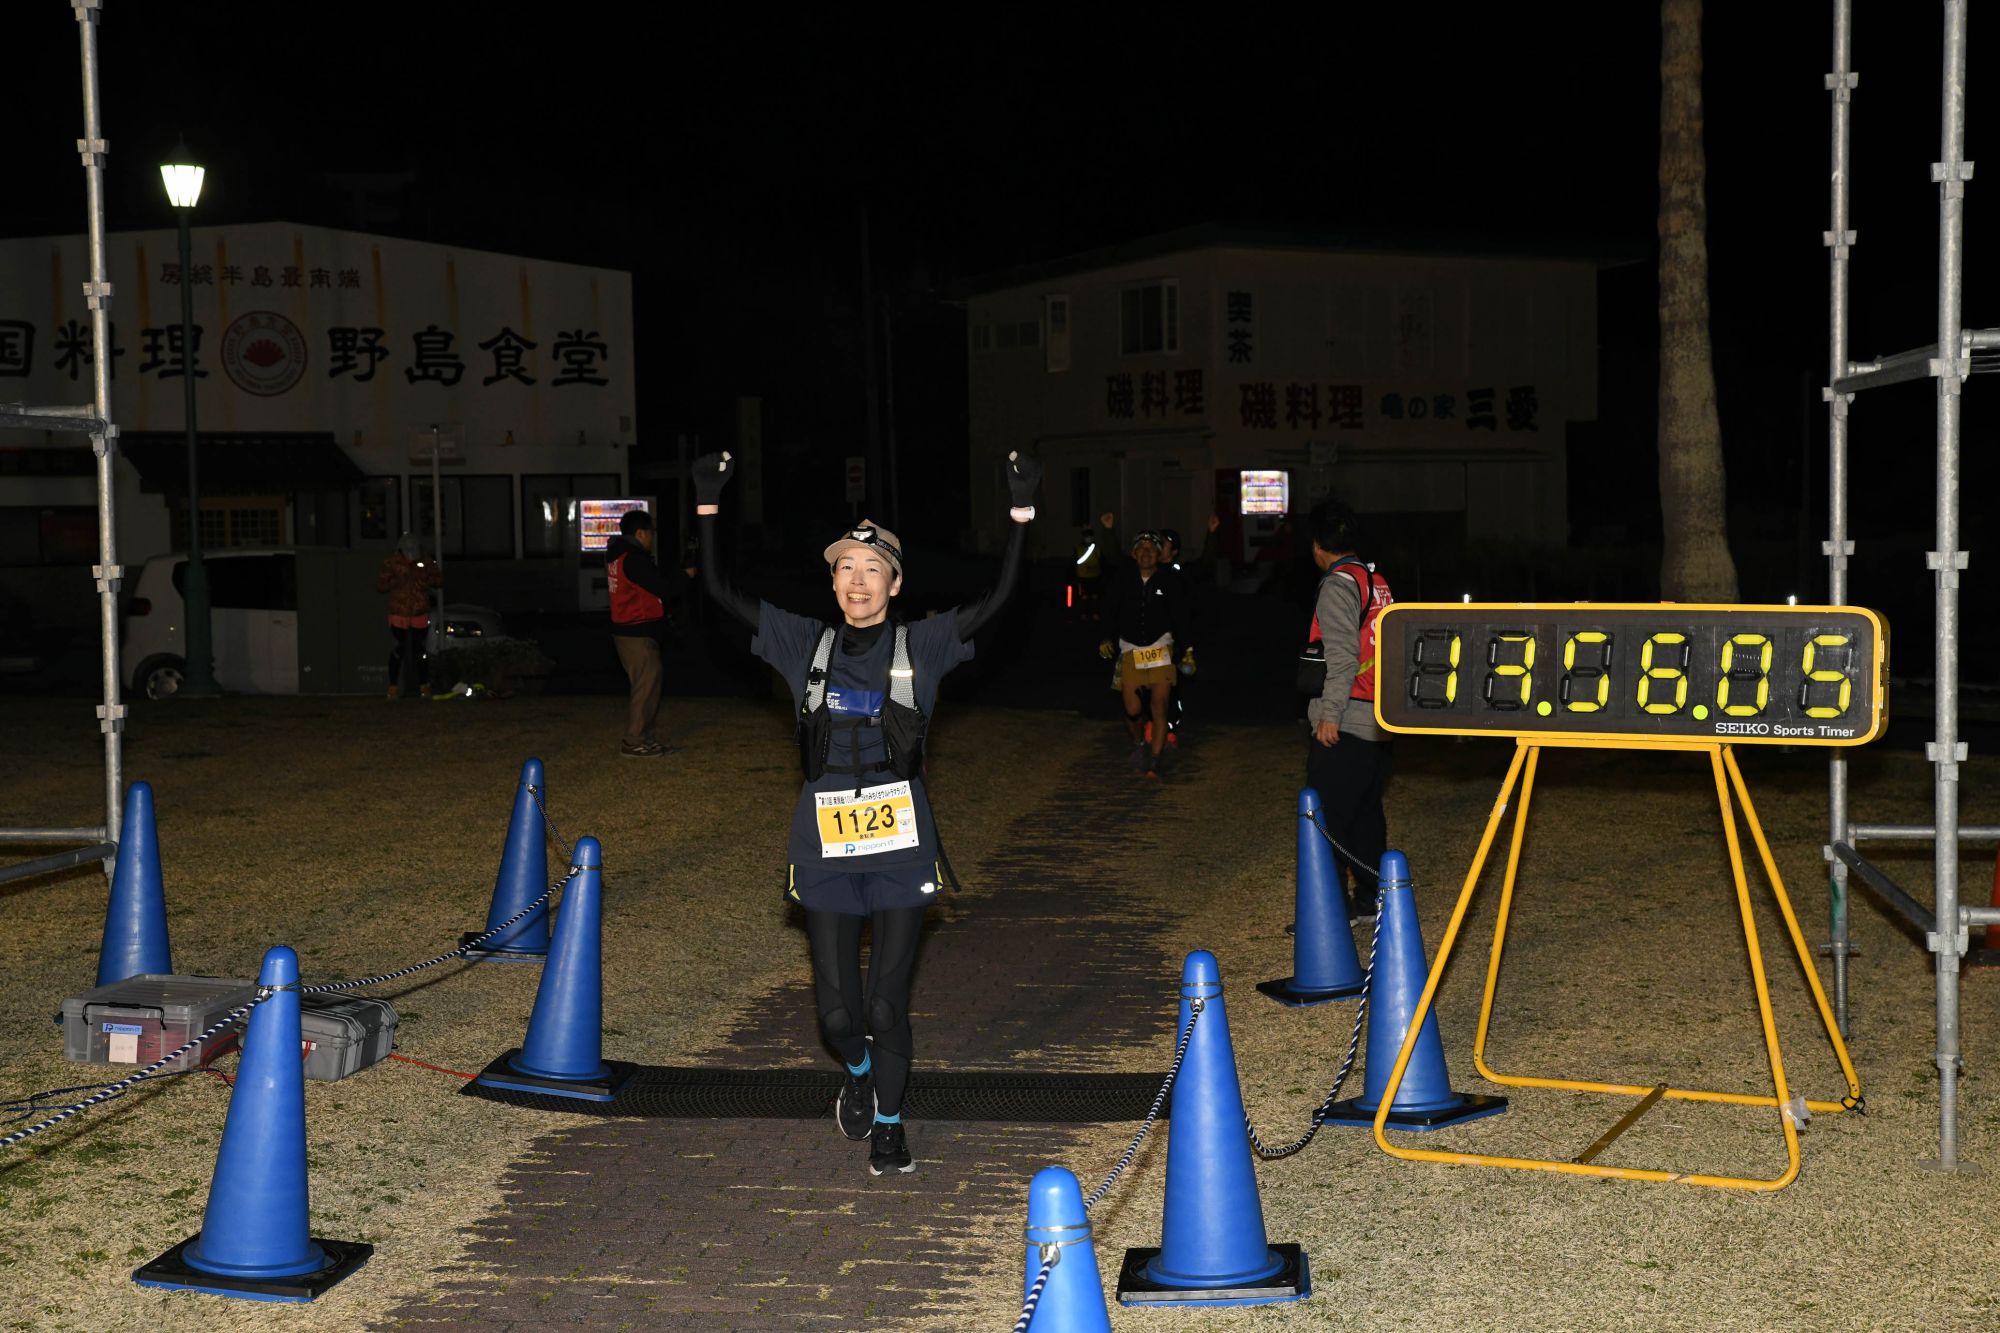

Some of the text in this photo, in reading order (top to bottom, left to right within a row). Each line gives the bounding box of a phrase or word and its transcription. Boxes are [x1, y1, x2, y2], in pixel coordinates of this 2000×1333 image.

[327, 325, 609, 386] 野島食堂
[1105, 369, 1203, 419] 磯料理
[1239, 383, 1364, 430] 磯料理
[1715, 722, 1855, 737] SEIKO Sports Timer
[833, 804, 895, 834] 1123
